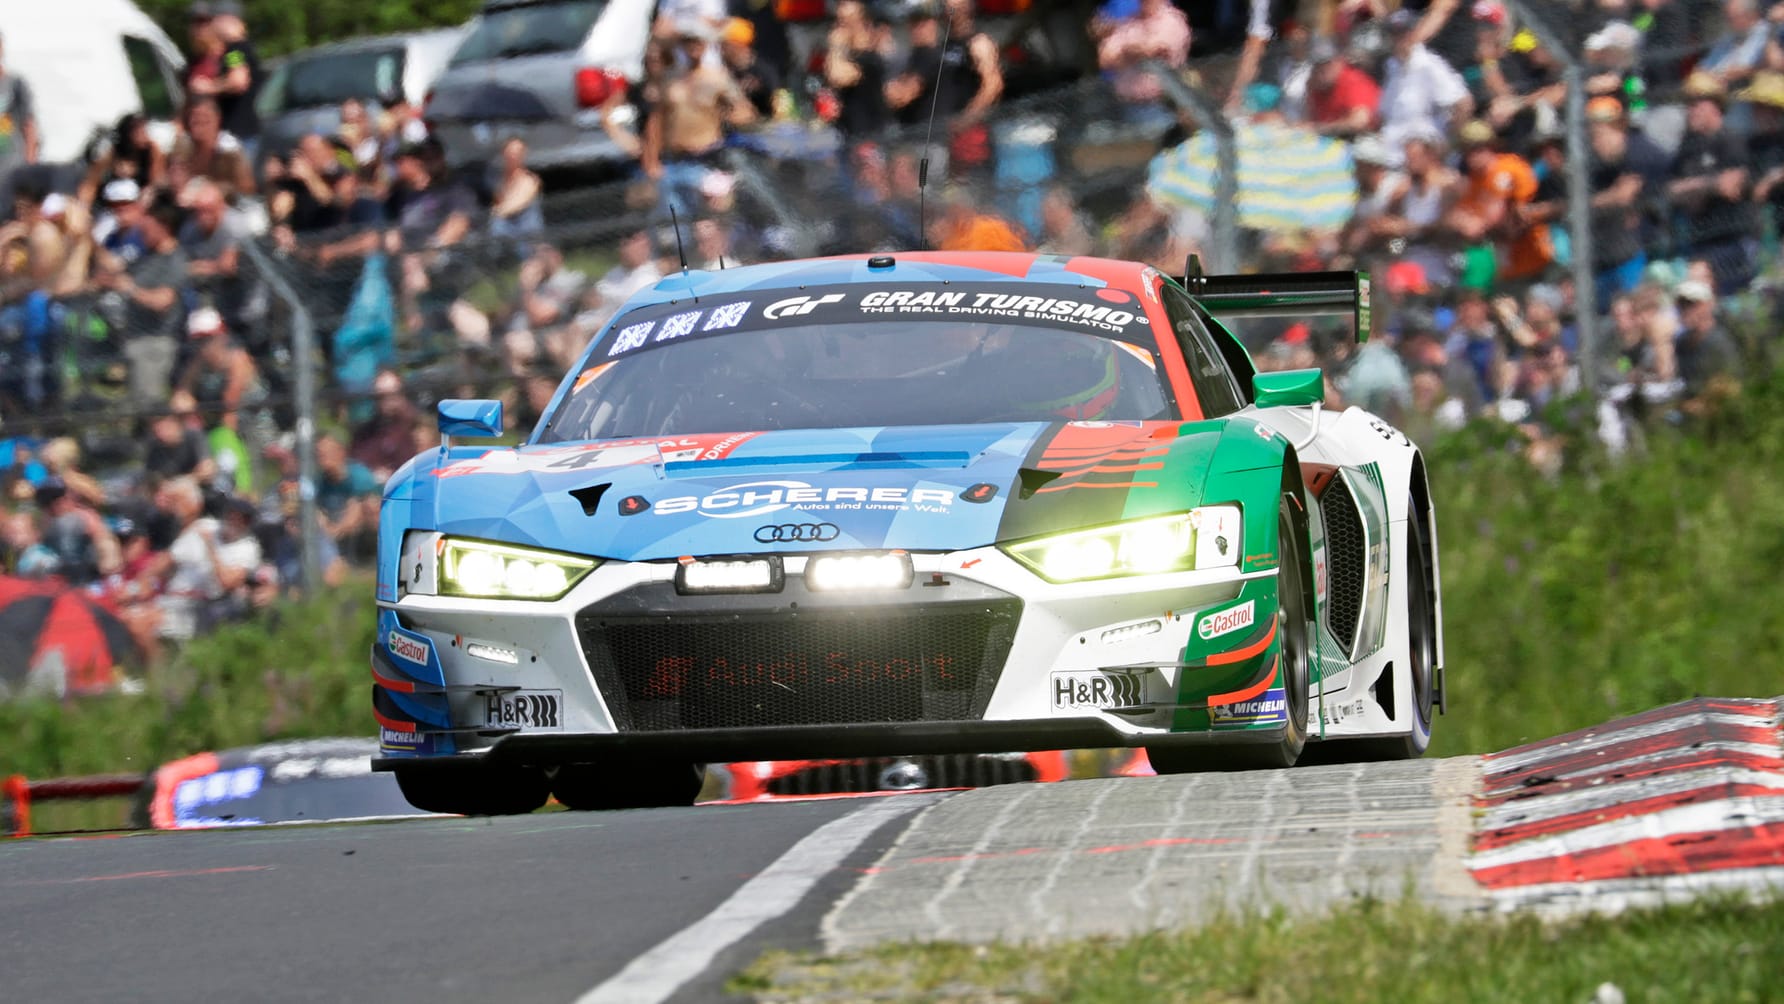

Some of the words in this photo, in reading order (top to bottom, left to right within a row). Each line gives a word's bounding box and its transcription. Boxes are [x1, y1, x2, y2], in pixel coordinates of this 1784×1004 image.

[860, 291, 967, 307] GRAN
[948, 307, 1019, 316] DRIVING
[1024, 312, 1123, 333] SIMULATOR
[545, 450, 605, 469] 4
[653, 487, 956, 515] SCHERER
[835, 502, 861, 510] sind
[866, 503, 909, 511] unsere
[1213, 606, 1252, 633] Castrol
[396, 636, 426, 663] Castrol
[1055, 677, 1109, 705] H&R
[487, 695, 530, 723] H&R
[1234, 700, 1285, 714] MICHELIN
